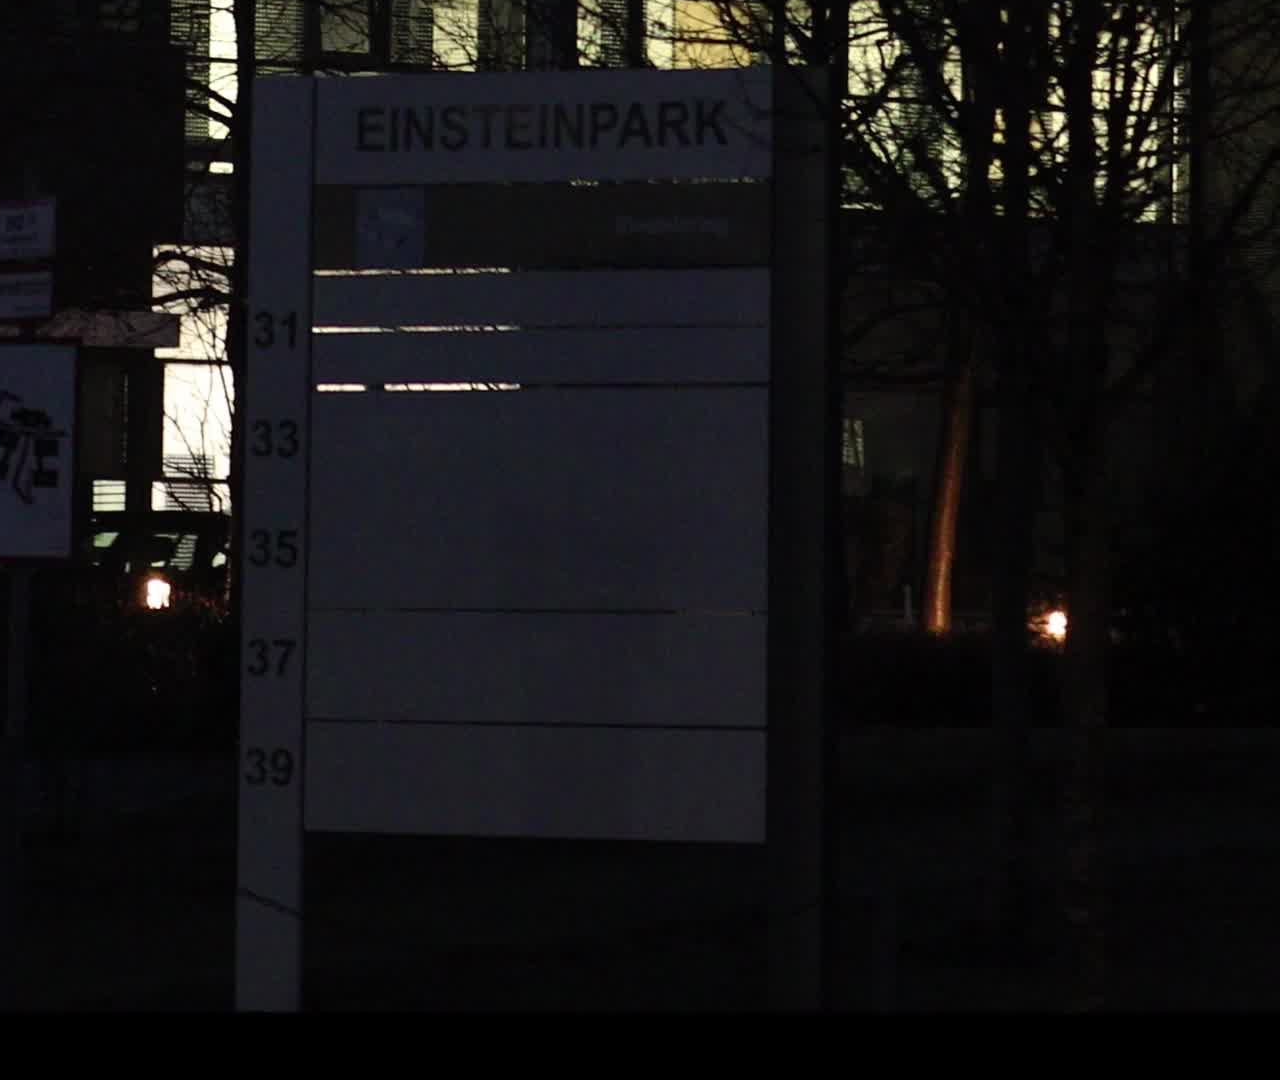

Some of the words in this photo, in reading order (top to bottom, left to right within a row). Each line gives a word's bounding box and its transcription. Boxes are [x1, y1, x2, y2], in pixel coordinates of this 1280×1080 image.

[355, 100, 729, 152] EINSTEINPARK
[253, 312, 298, 350] 31
[249, 420, 299, 458] 33
[248, 530, 299, 568] 35
[246, 639, 297, 678] 37
[244, 748, 295, 787] 39
